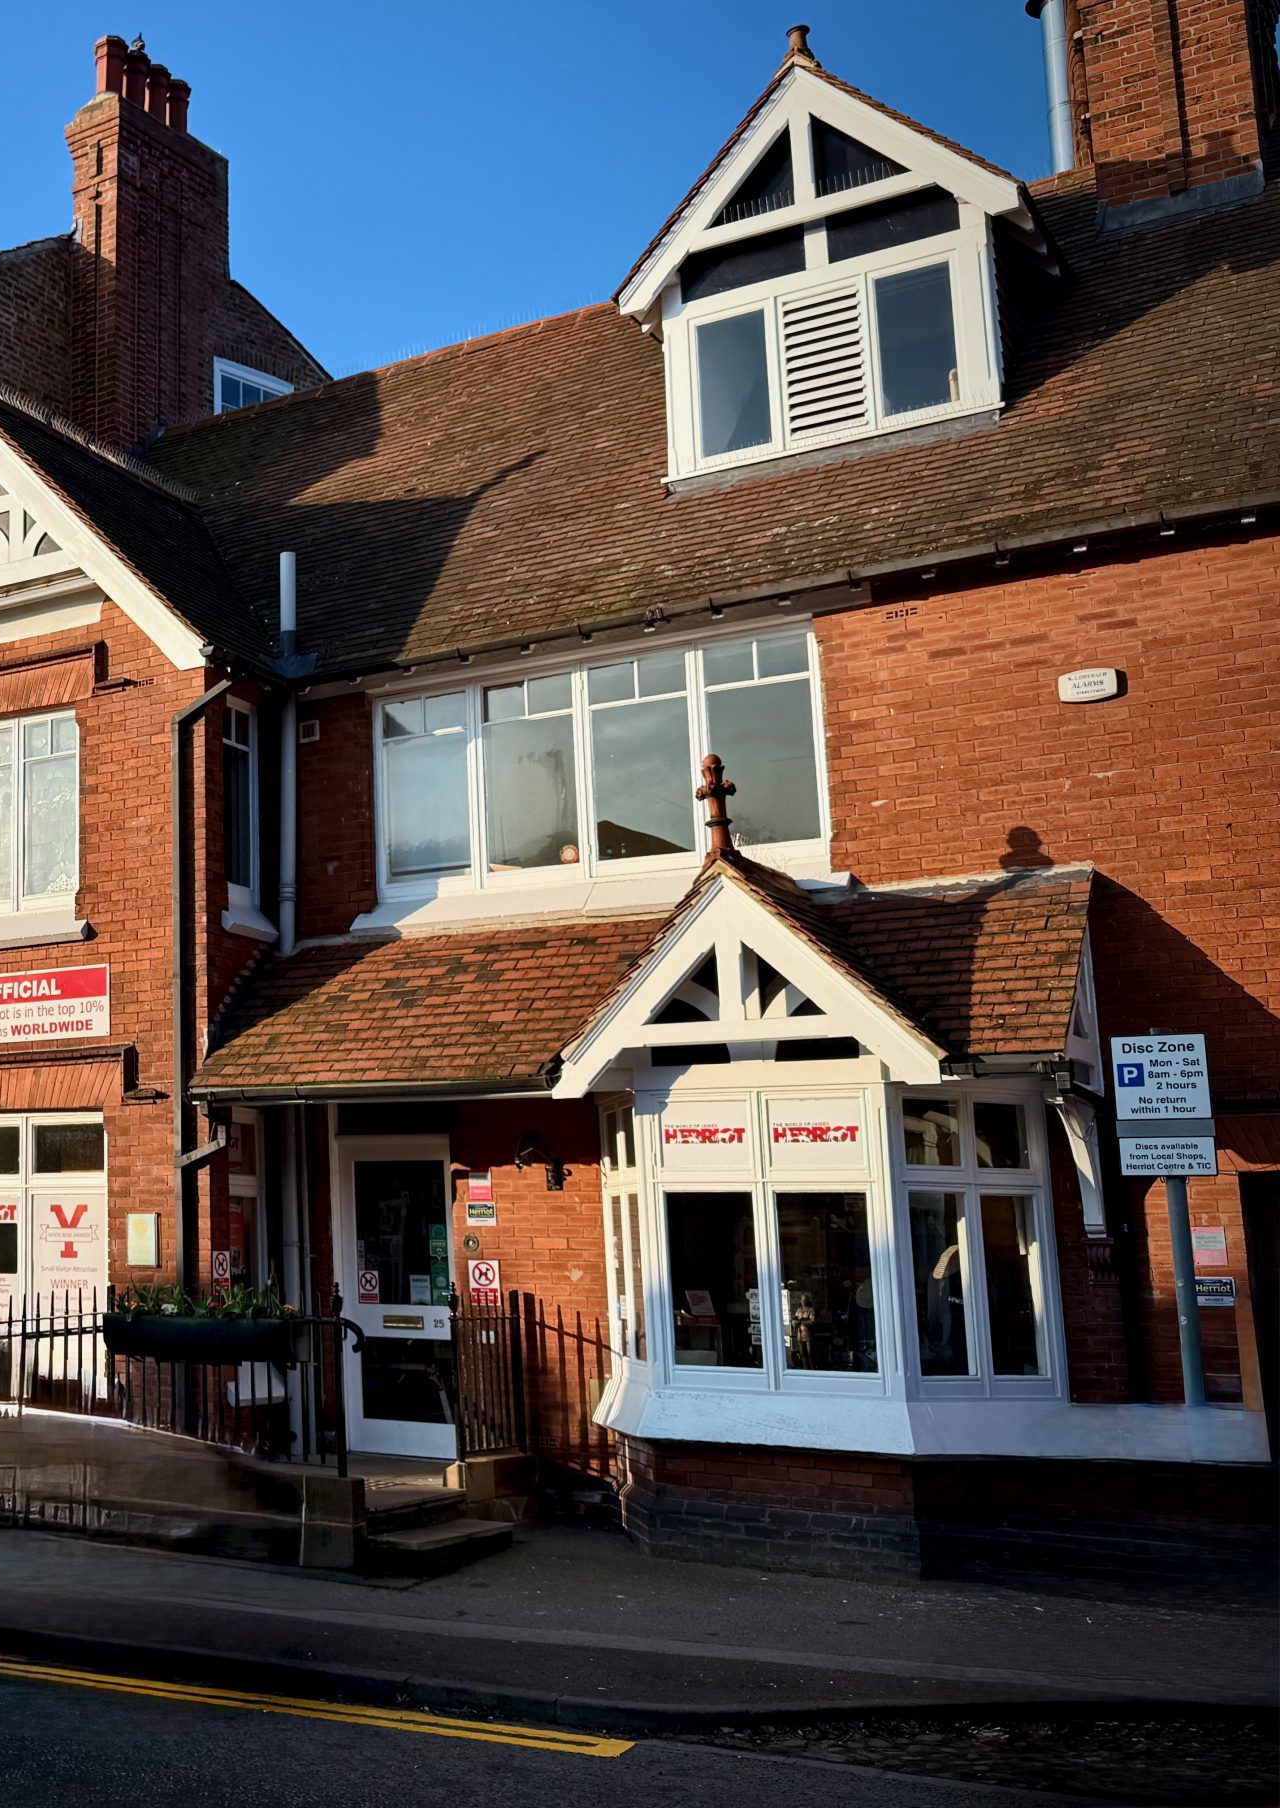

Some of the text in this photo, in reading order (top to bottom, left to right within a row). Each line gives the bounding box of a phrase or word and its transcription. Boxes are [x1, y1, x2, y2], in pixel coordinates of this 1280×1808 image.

[1072, 680, 1104, 689] ALARMS
[13, 1007, 22, 1019] is
[24, 1006, 34, 1018] in
[37, 1004, 54, 1017] the
[58, 1004, 76, 1018] top
[80, 1000, 104, 1014] 10%
[11, 1019, 94, 1036] WORLDWIDE
[1122, 1042, 1195, 1054] Disc Zone
[1150, 1060, 1172, 1068] Mon
[1182, 1058, 1200, 1066] Sat
[1123, 1066, 1138, 1084] P
[1148, 1071, 1170, 1079] 8am
[1180, 1070, 1204, 1080] 6pm
[1166, 1081, 1197, 1090] hours
[1138, 1096, 1186, 1104] No return
[1130, 1106, 1160, 1114] within
[1173, 1105, 1196, 1113] hour
[50, 1279, 88, 1289] WINNER
[1196, 1284, 1232, 1292] Herriot
[434, 1319, 444, 1328] 25
